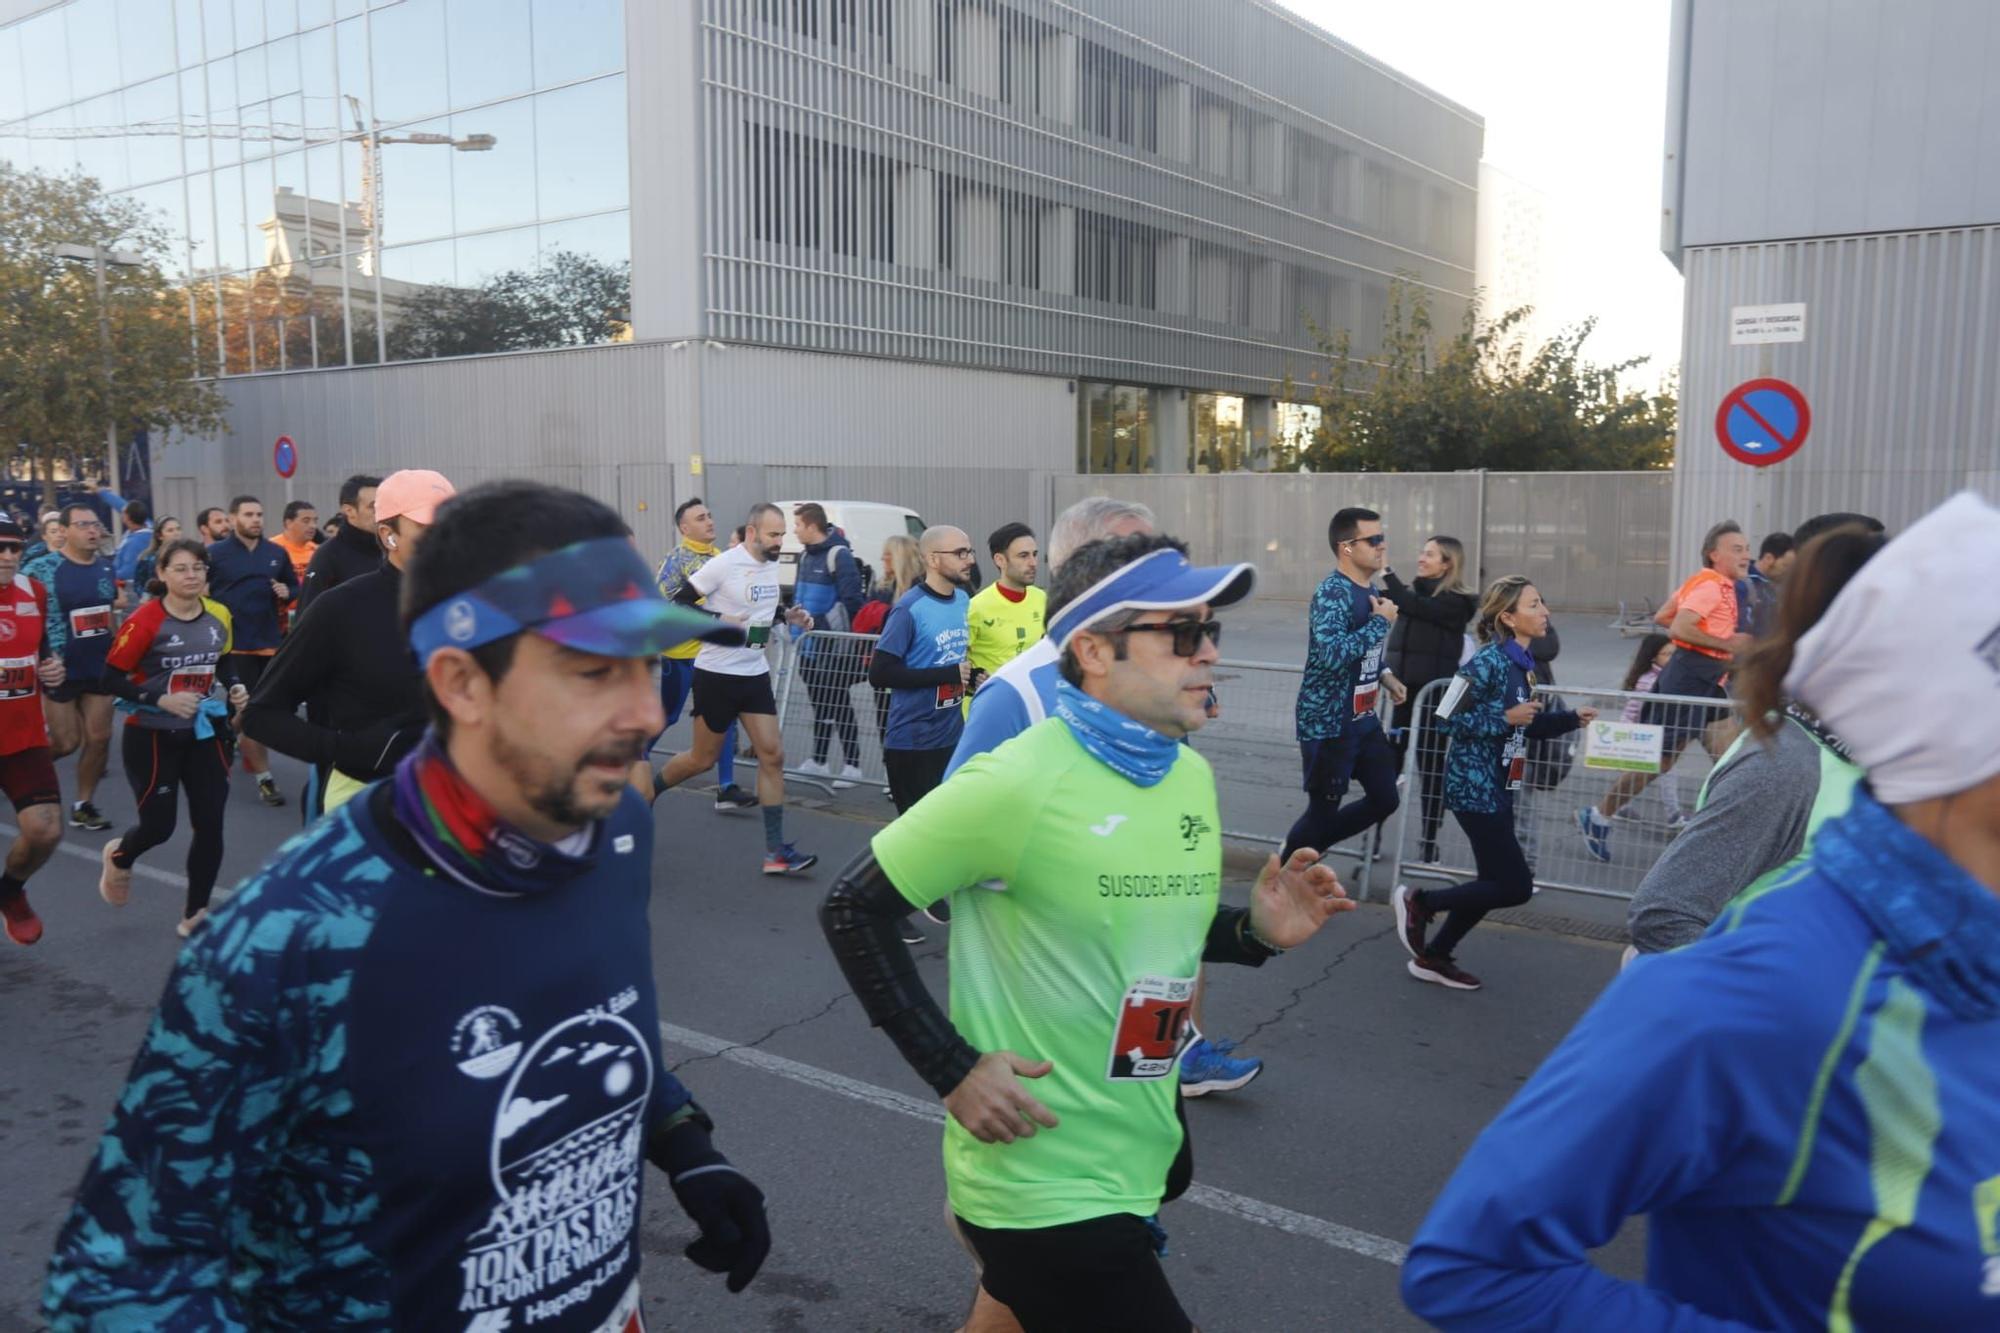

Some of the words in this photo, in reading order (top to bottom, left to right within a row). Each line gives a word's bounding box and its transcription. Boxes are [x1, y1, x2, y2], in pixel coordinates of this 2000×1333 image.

[459, 1239, 529, 1291] 10K
[533, 1209, 590, 1271] PAS
[594, 1176, 638, 1238] RAS
[458, 1287, 488, 1312] AL
[490, 1266, 546, 1306] PORT
[547, 1253, 573, 1285] DE
